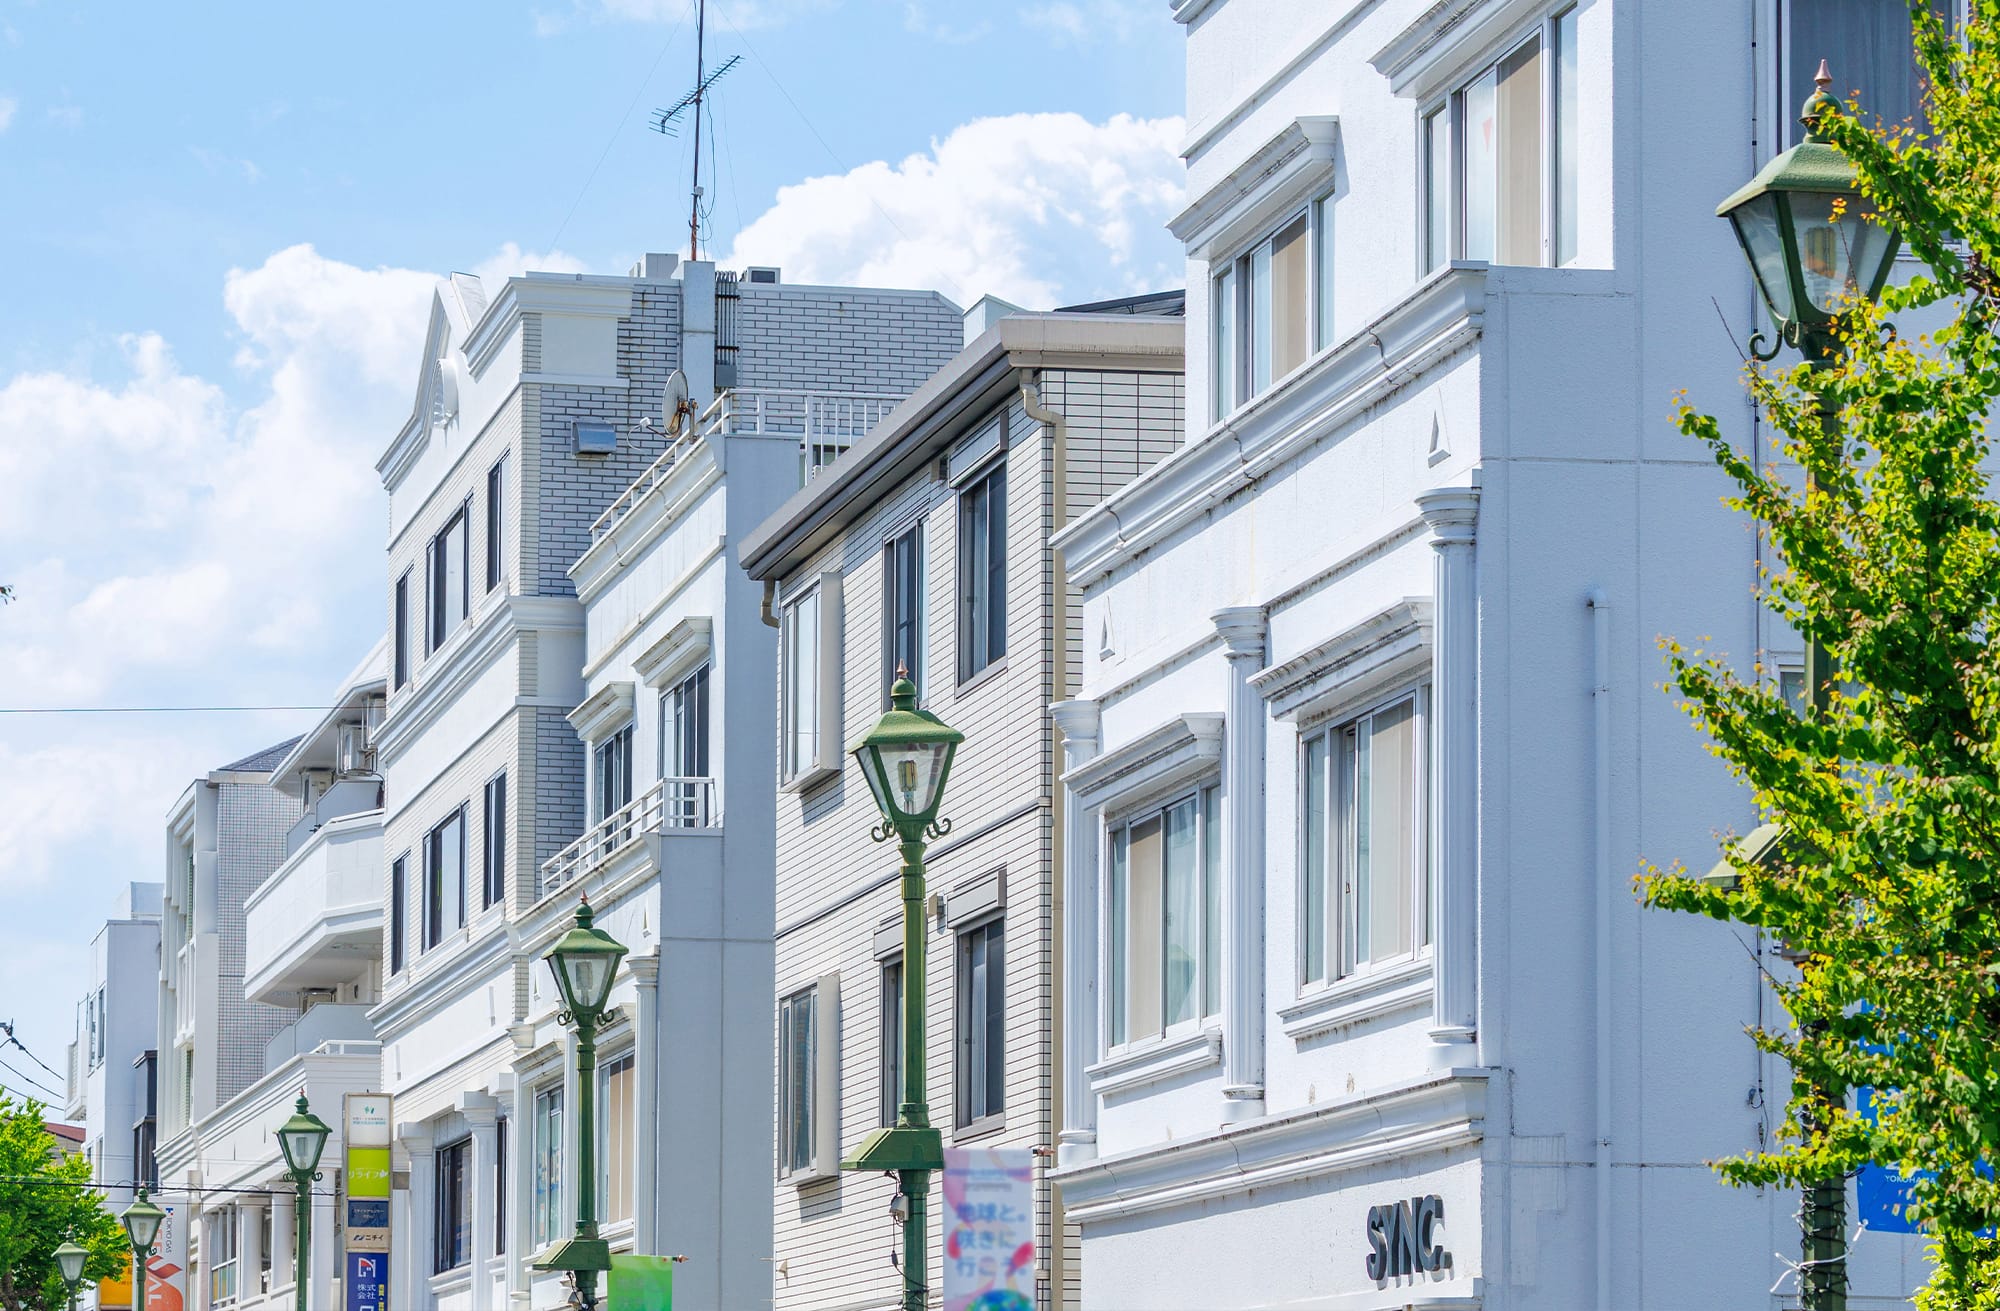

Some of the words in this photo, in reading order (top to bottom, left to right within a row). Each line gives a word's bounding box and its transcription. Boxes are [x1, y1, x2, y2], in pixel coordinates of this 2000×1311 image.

[165, 1240, 173, 1254] GAS
[357, 1284, 376, 1292] 株式
[357, 1292, 376, 1300] 会社
